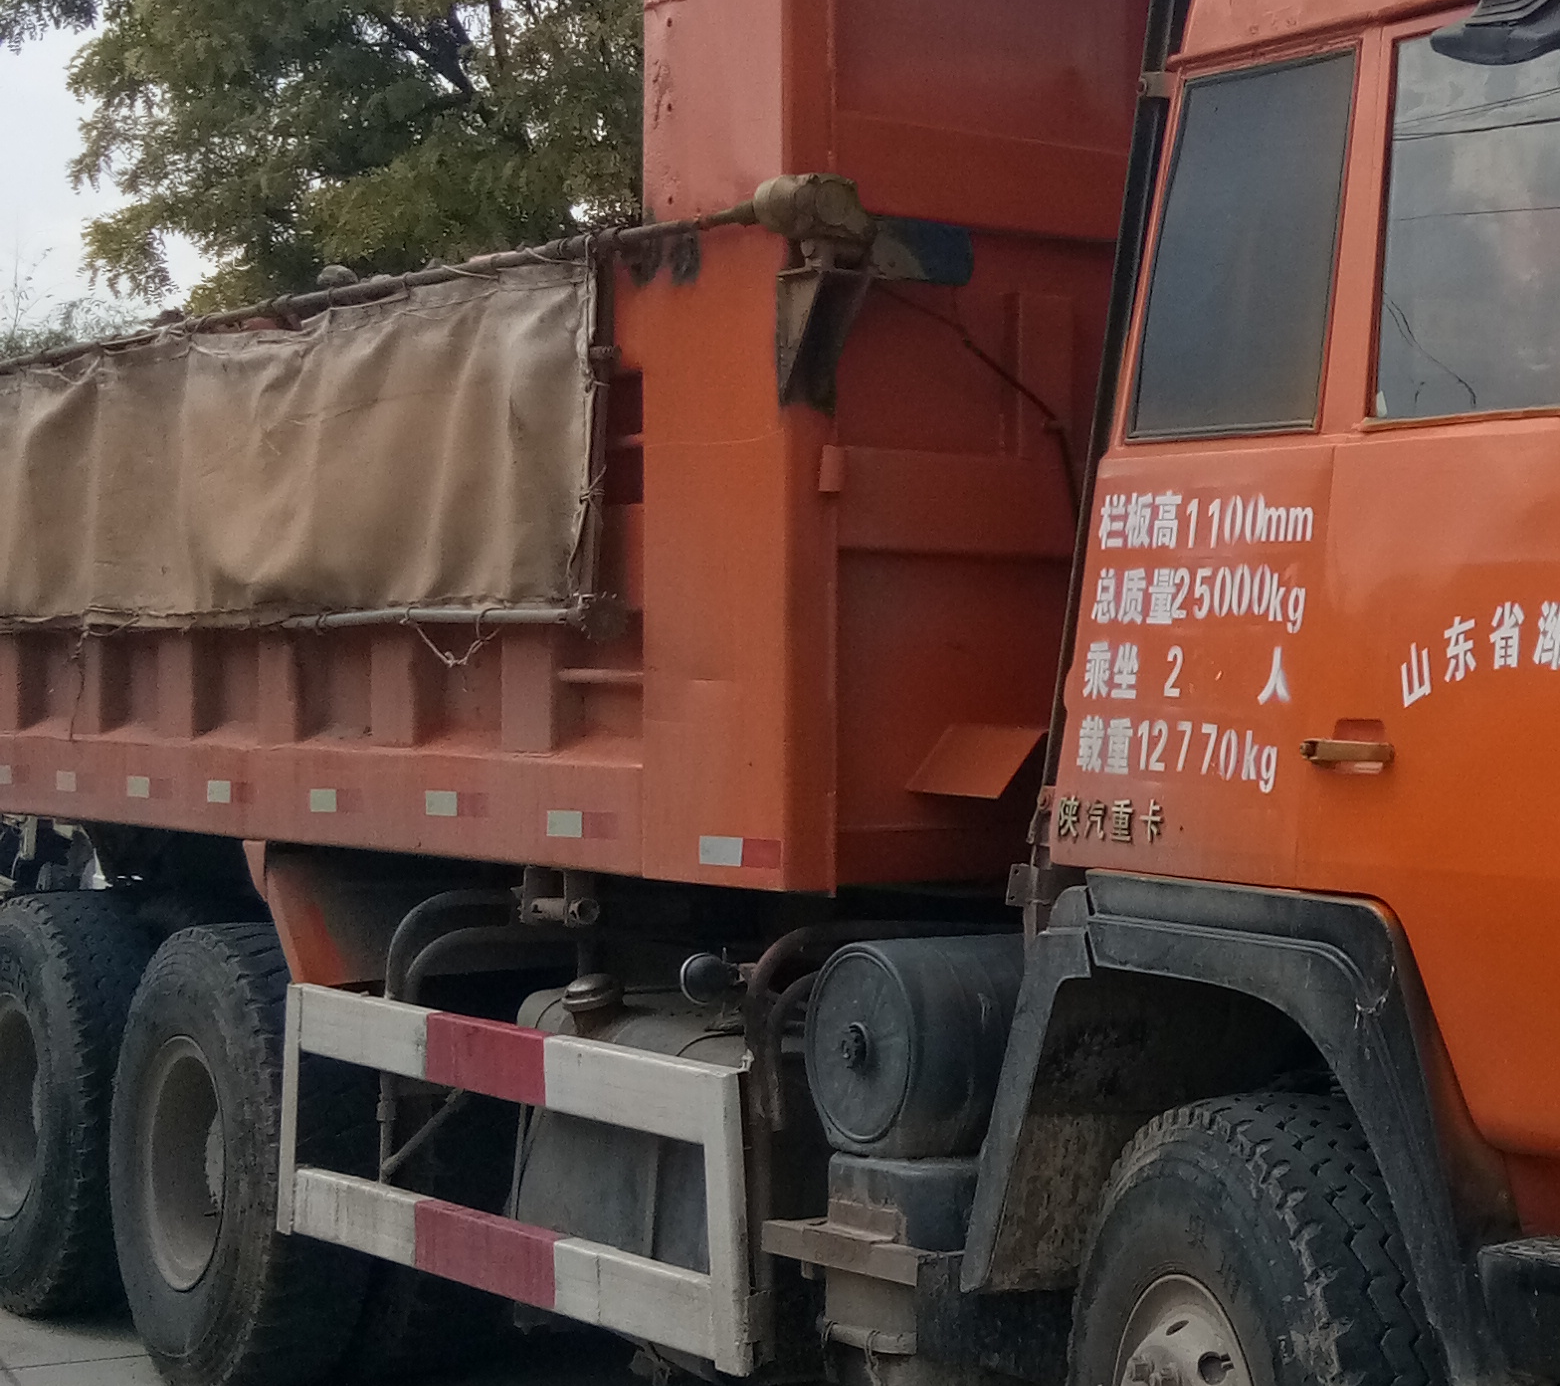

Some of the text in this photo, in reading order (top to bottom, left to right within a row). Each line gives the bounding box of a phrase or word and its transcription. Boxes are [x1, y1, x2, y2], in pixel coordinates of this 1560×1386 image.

[1162, 644, 1185, 699] 2
[1256, 645, 1293, 707] 人
[1058, 794, 1164, 844] 陕汽重卡
